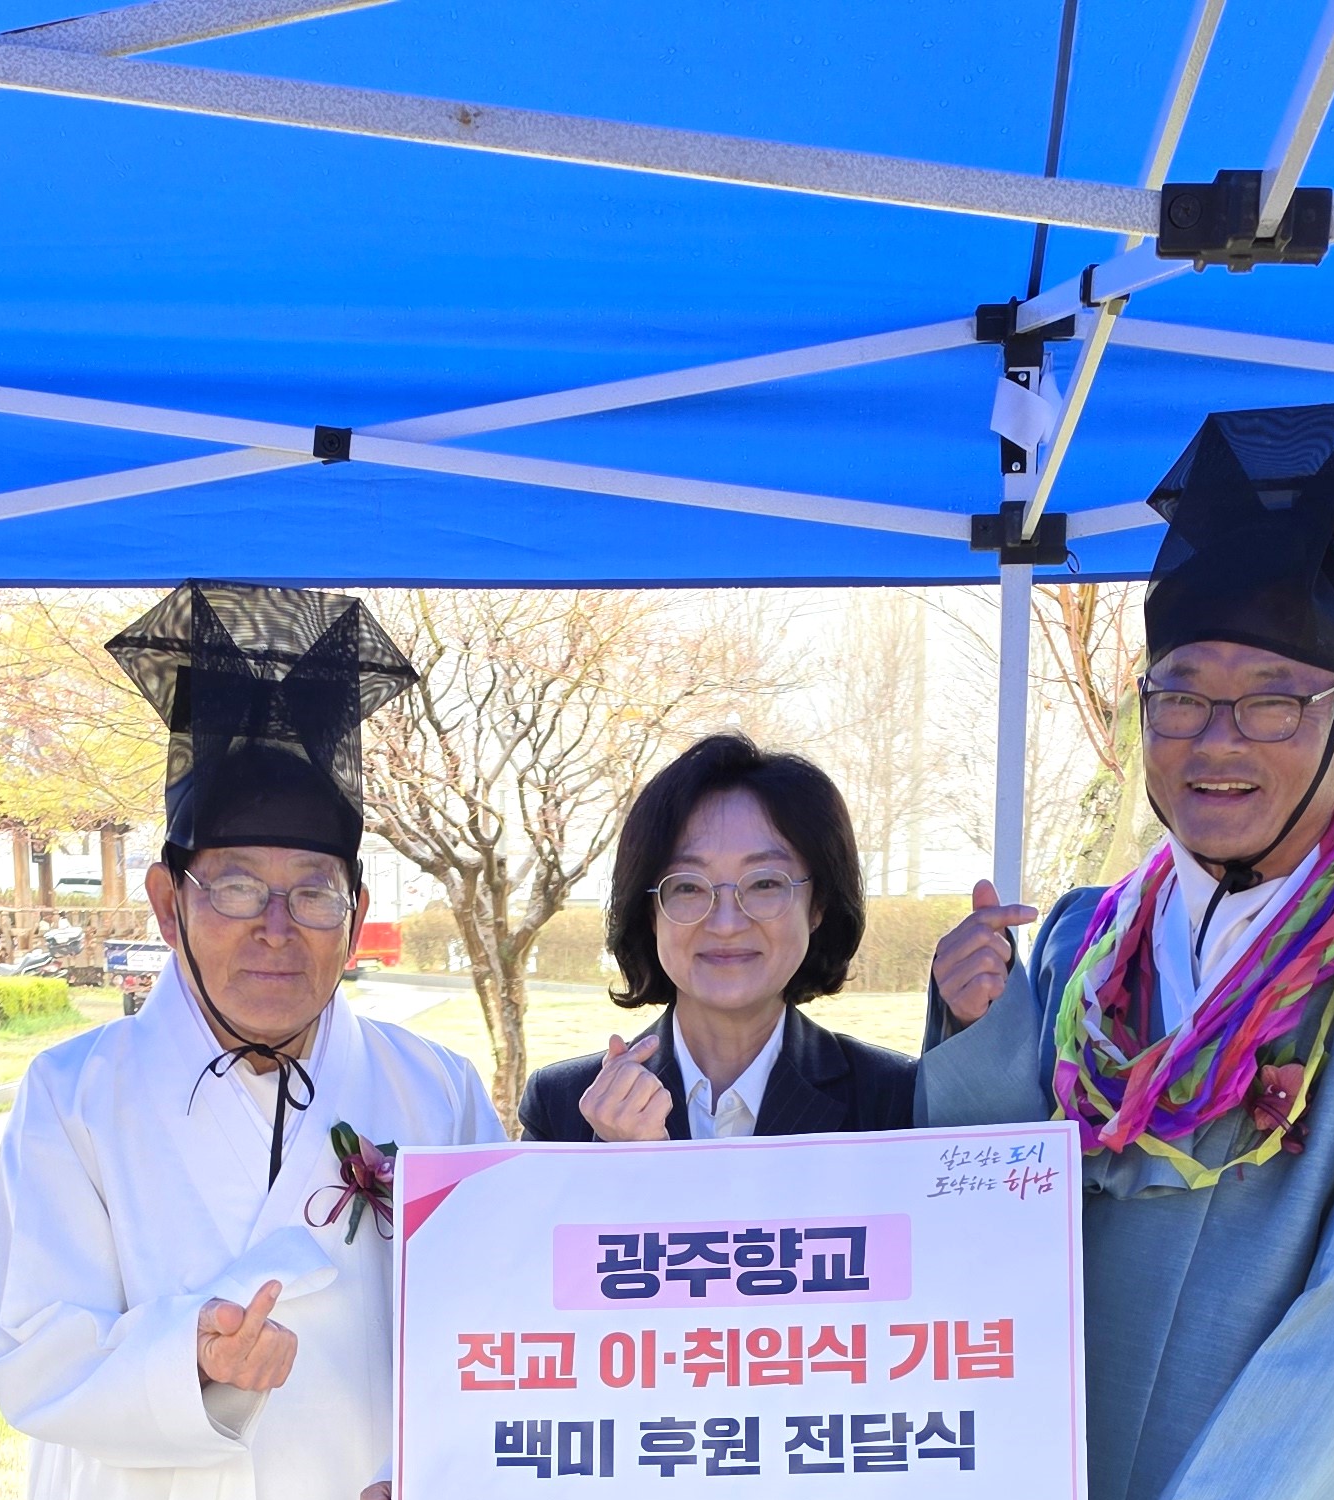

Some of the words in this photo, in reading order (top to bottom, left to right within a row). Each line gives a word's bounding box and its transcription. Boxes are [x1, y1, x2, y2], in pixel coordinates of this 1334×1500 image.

[926, 1174, 998, 1198] 도약하는
[1003, 1166, 1060, 1200] 하남
[939, 1145, 972, 1171] 살고
[974, 1146, 1001, 1167] 싶은
[1005, 1141, 1045, 1165] 도시
[596, 1225, 870, 1300] 광주향교
[457, 1331, 578, 1392] 전교
[598, 1324, 868, 1389] 이·취임식
[888, 1318, 1015, 1382] 기념
[493, 1418, 615, 1480] 백미
[637, 1415, 760, 1479] 후원
[784, 1410, 976, 1475] 전달식
